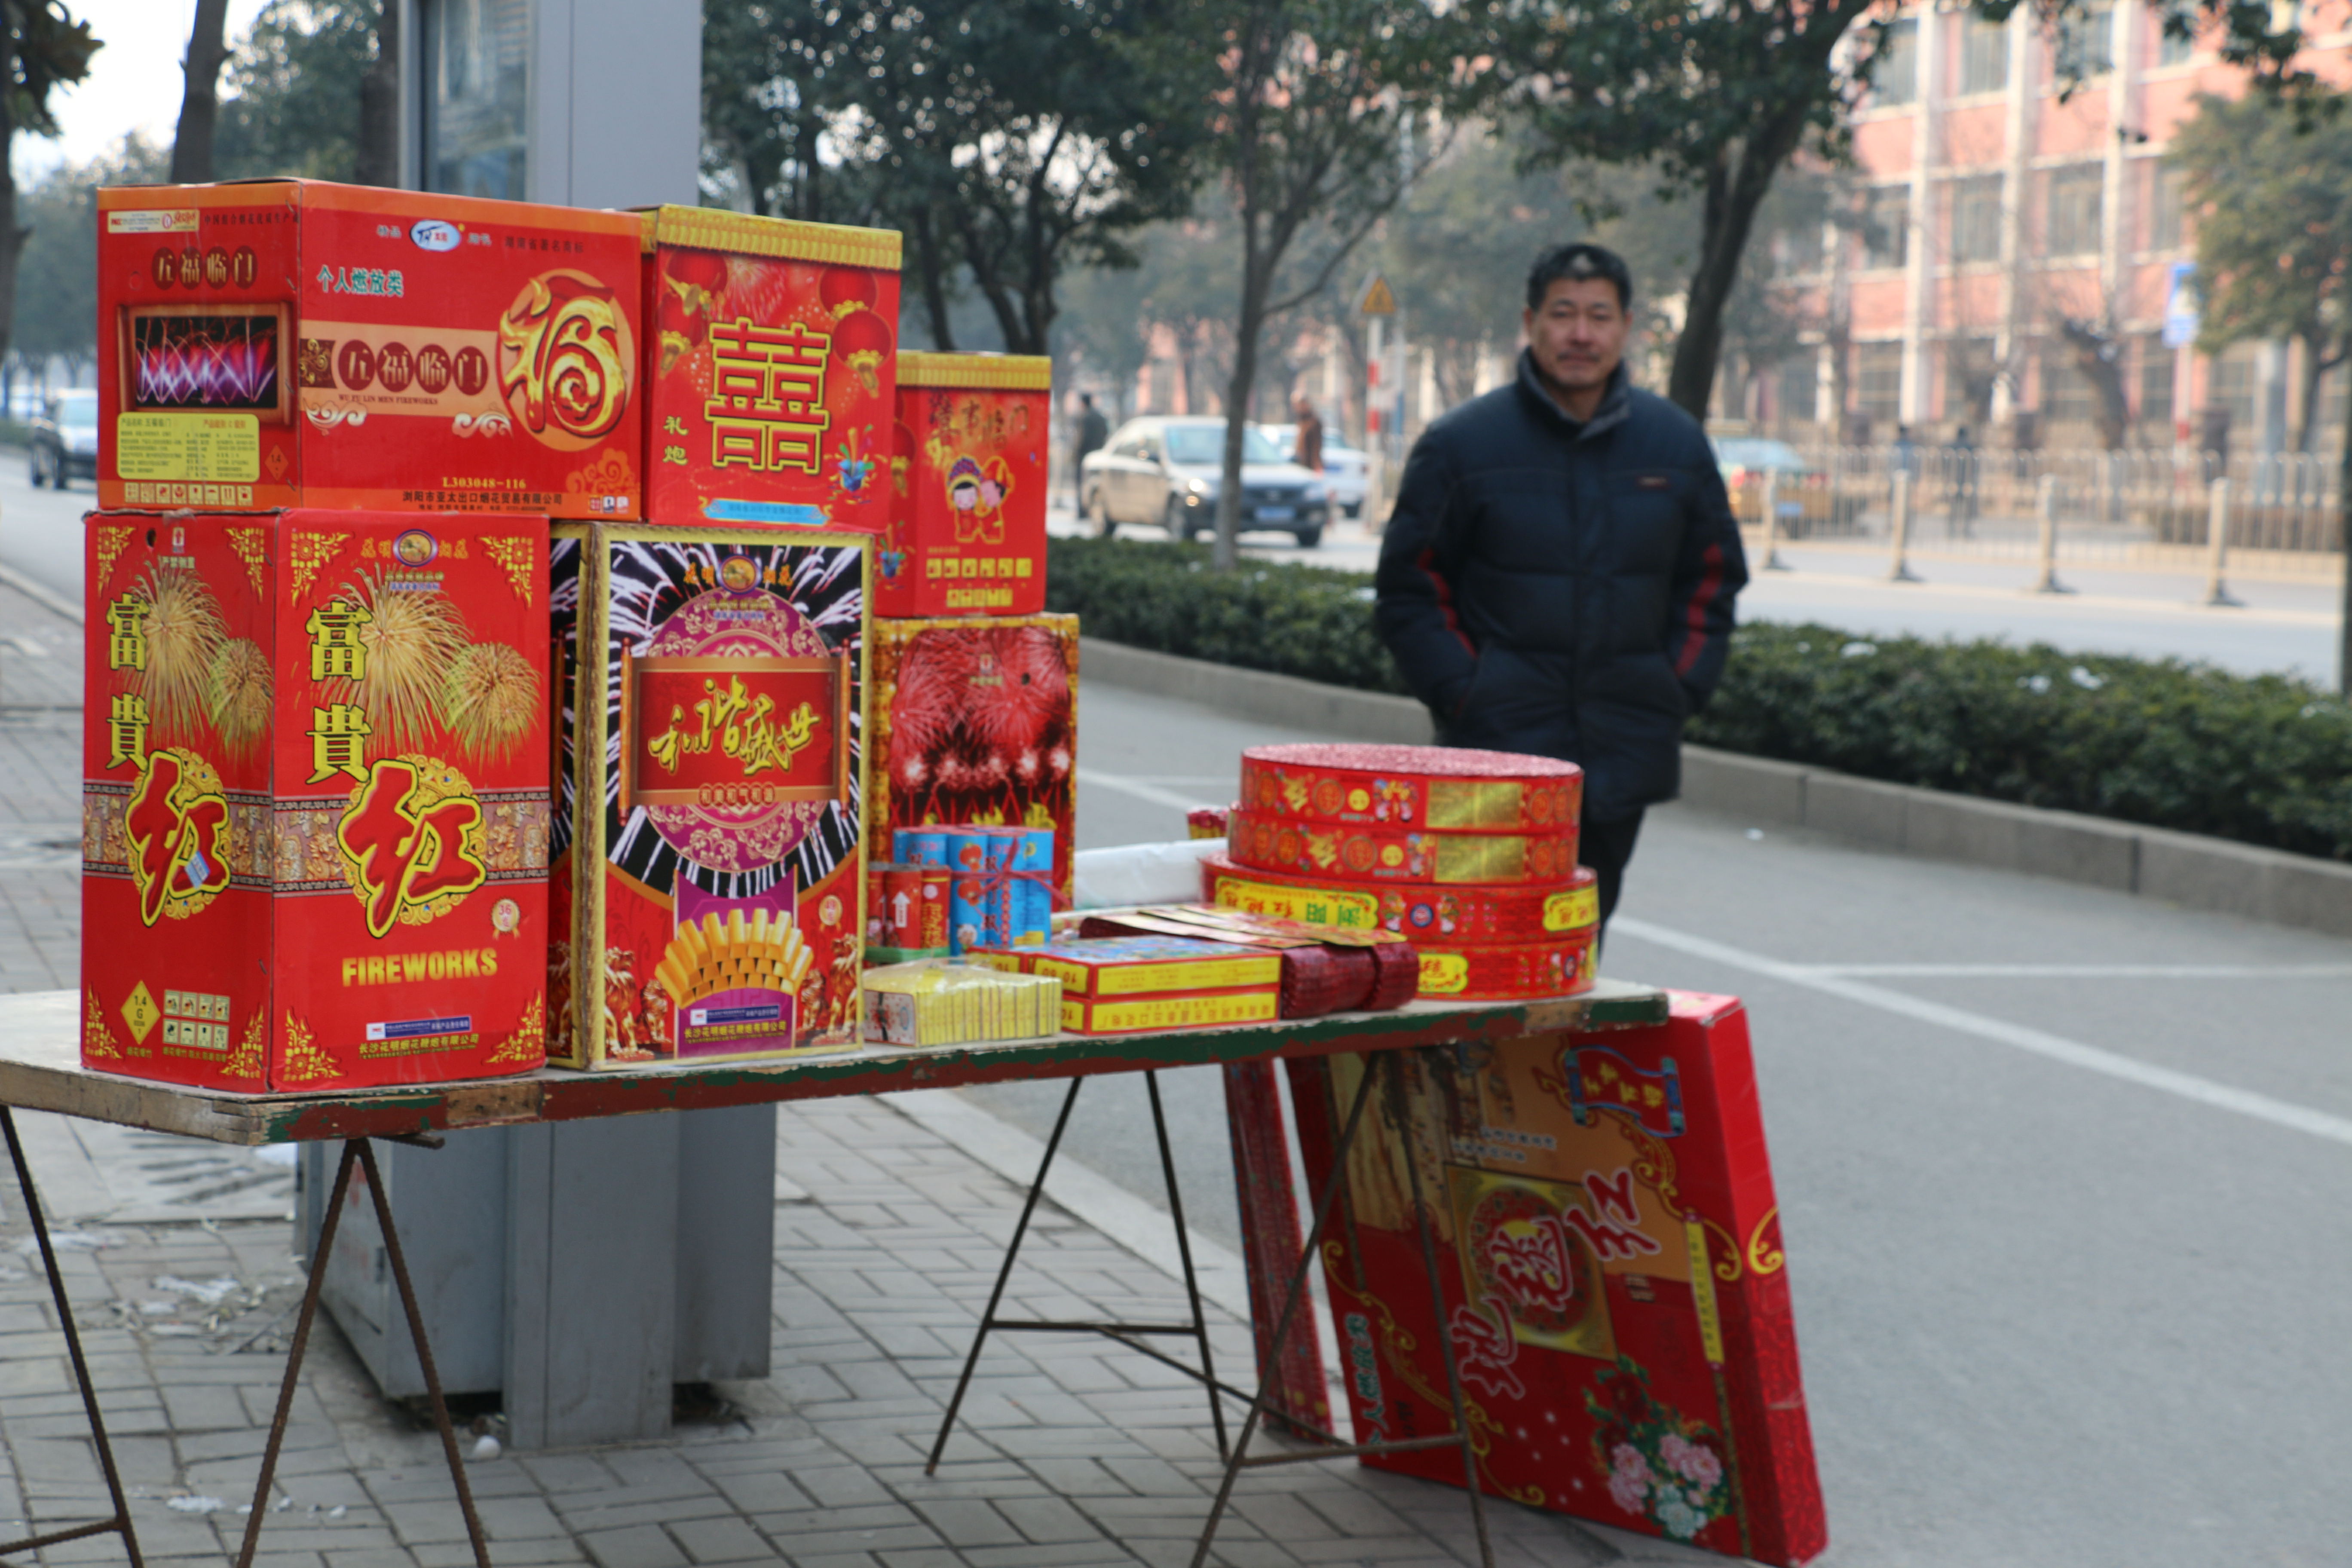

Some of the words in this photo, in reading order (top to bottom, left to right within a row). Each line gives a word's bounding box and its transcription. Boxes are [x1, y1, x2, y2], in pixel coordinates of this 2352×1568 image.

[317, 264, 404, 299] 个人燃放类
[344, 346, 483, 388] 五福临门
[396, 396, 438, 405] FIREWORKS
[662, 415, 688, 466] 礼炮
[442, 476, 527, 490] L303048-116
[342, 948, 498, 986] FIREWORKS
[134, 995, 147, 1006] 1.4
[136, 1008, 143, 1019] G
